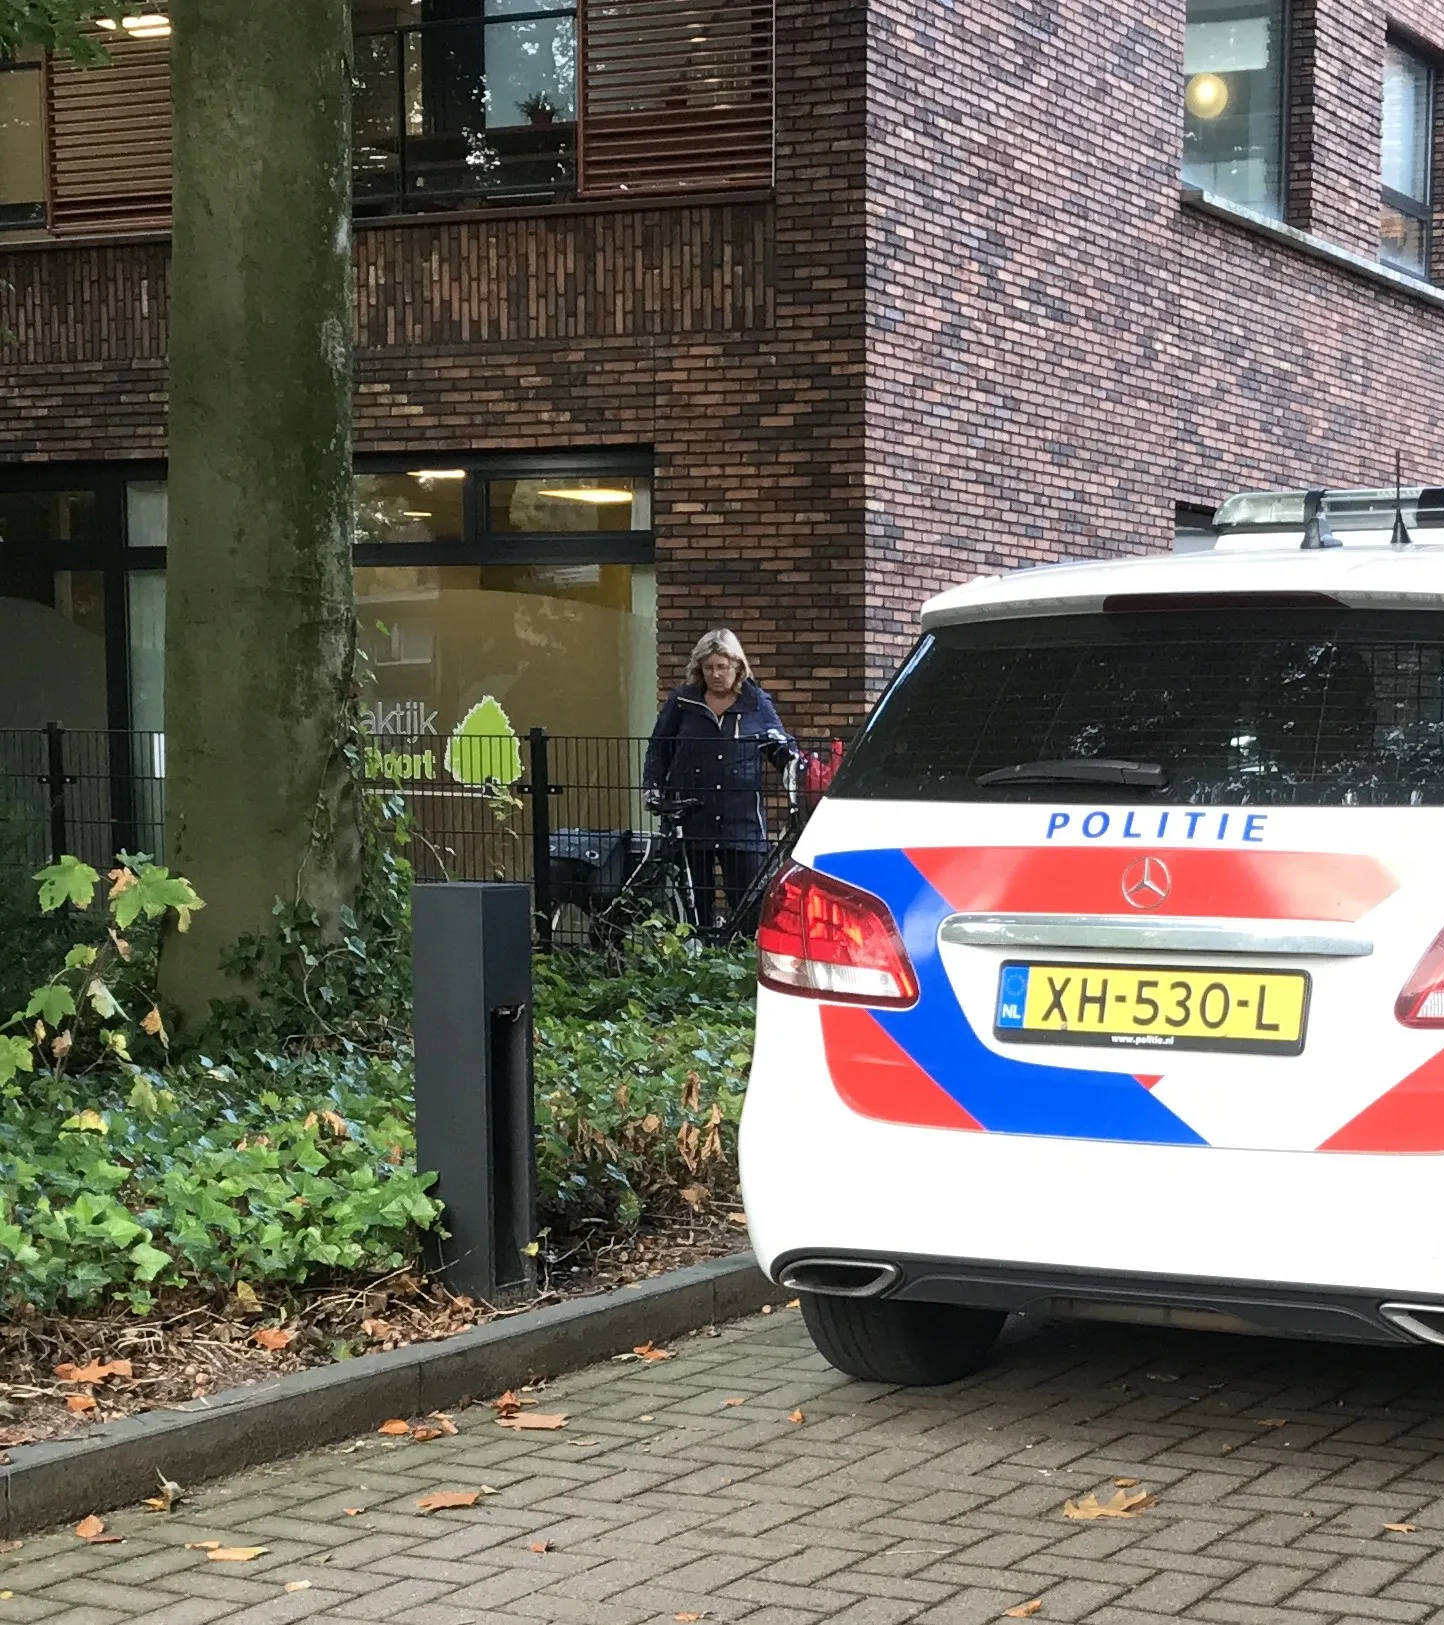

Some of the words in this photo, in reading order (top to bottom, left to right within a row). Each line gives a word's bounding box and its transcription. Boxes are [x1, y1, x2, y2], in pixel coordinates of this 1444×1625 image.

[360, 701, 439, 744] aktijk
[1046, 811, 1268, 842] POLITIE
[1001, 1002, 1021, 1019] NL
[1041, 976, 1281, 1032] XH-530-L
[1111, 1034, 1174, 1046] www.politie.nl
